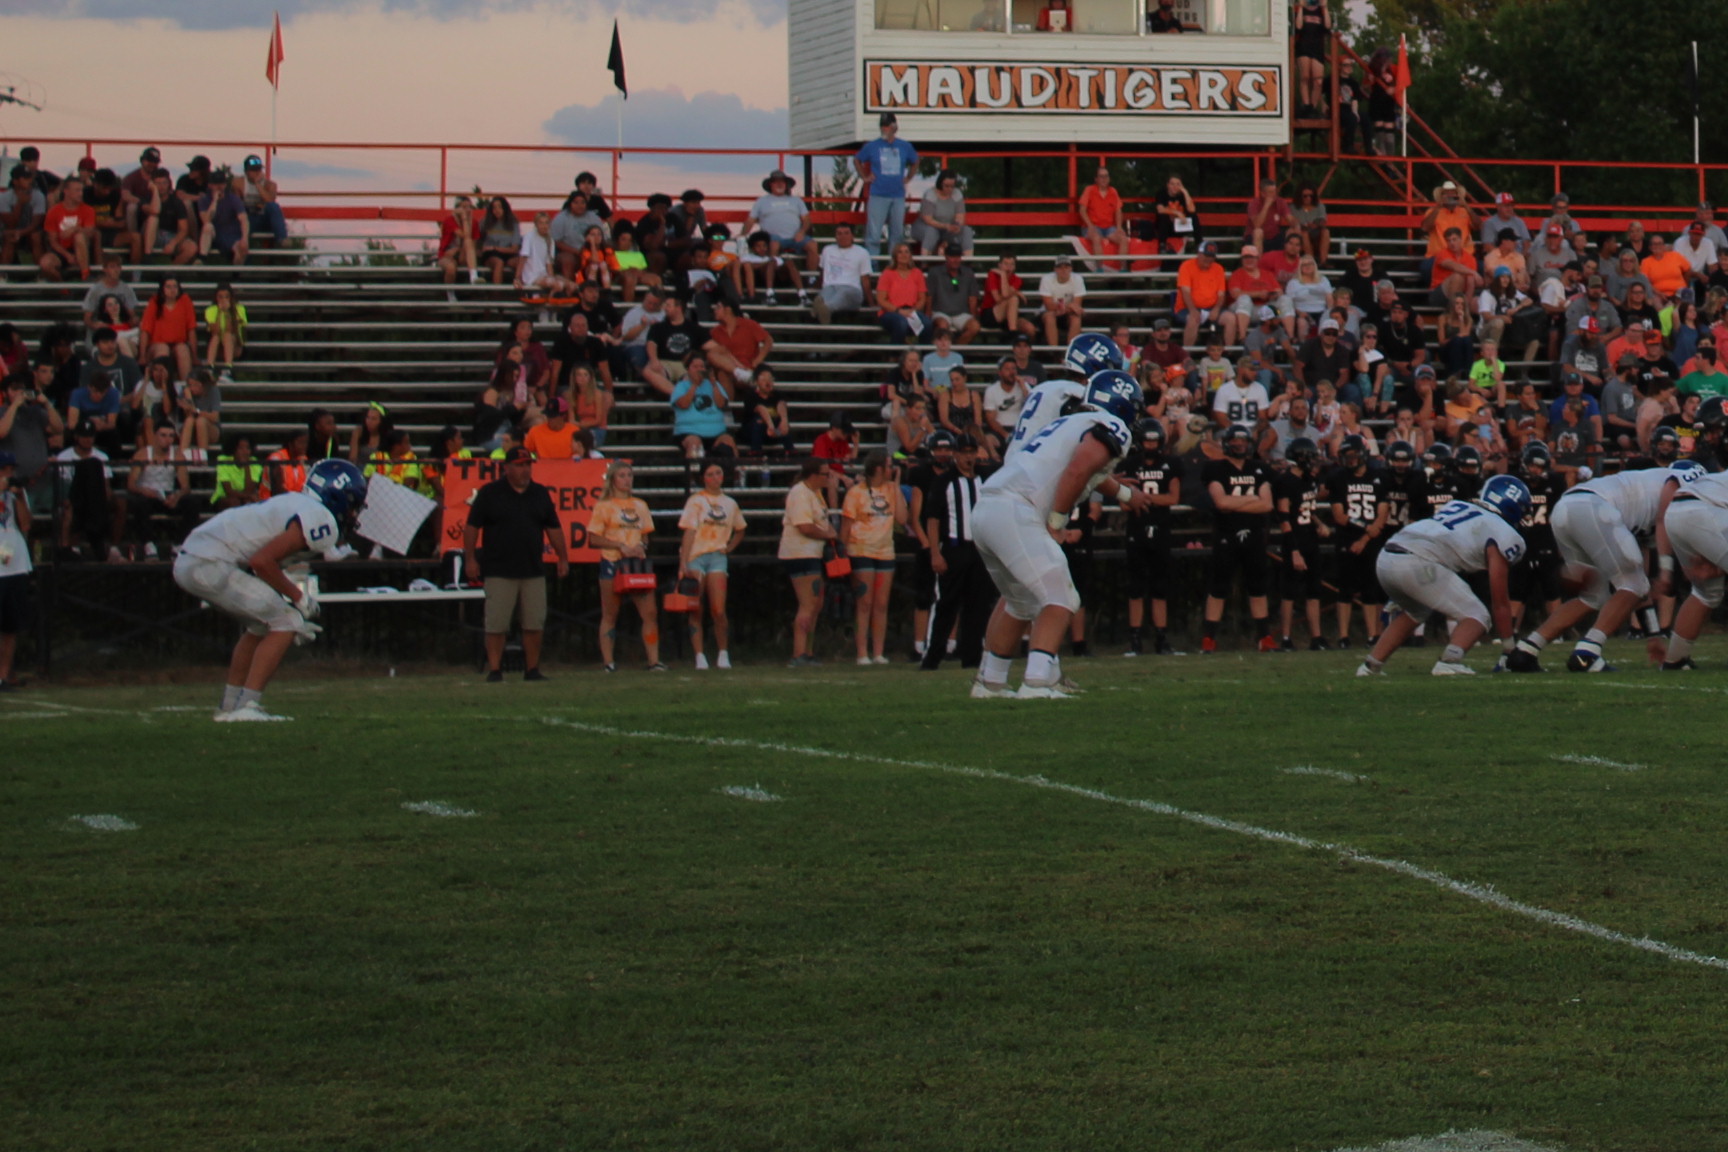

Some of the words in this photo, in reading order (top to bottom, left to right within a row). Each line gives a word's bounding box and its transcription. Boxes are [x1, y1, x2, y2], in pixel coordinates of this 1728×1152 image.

[880, 65, 1057, 107] MAUD
[1067, 67, 1268, 110] TIGERS
[1088, 341, 1109, 361] 12
[1112, 377, 1134, 400] 32
[332, 472, 351, 490] 5
[1229, 475, 1256, 486] MAUD
[1347, 483, 1375, 494] MAUD
[1346, 493, 1377, 520] 55
[310, 524, 331, 541] 5
